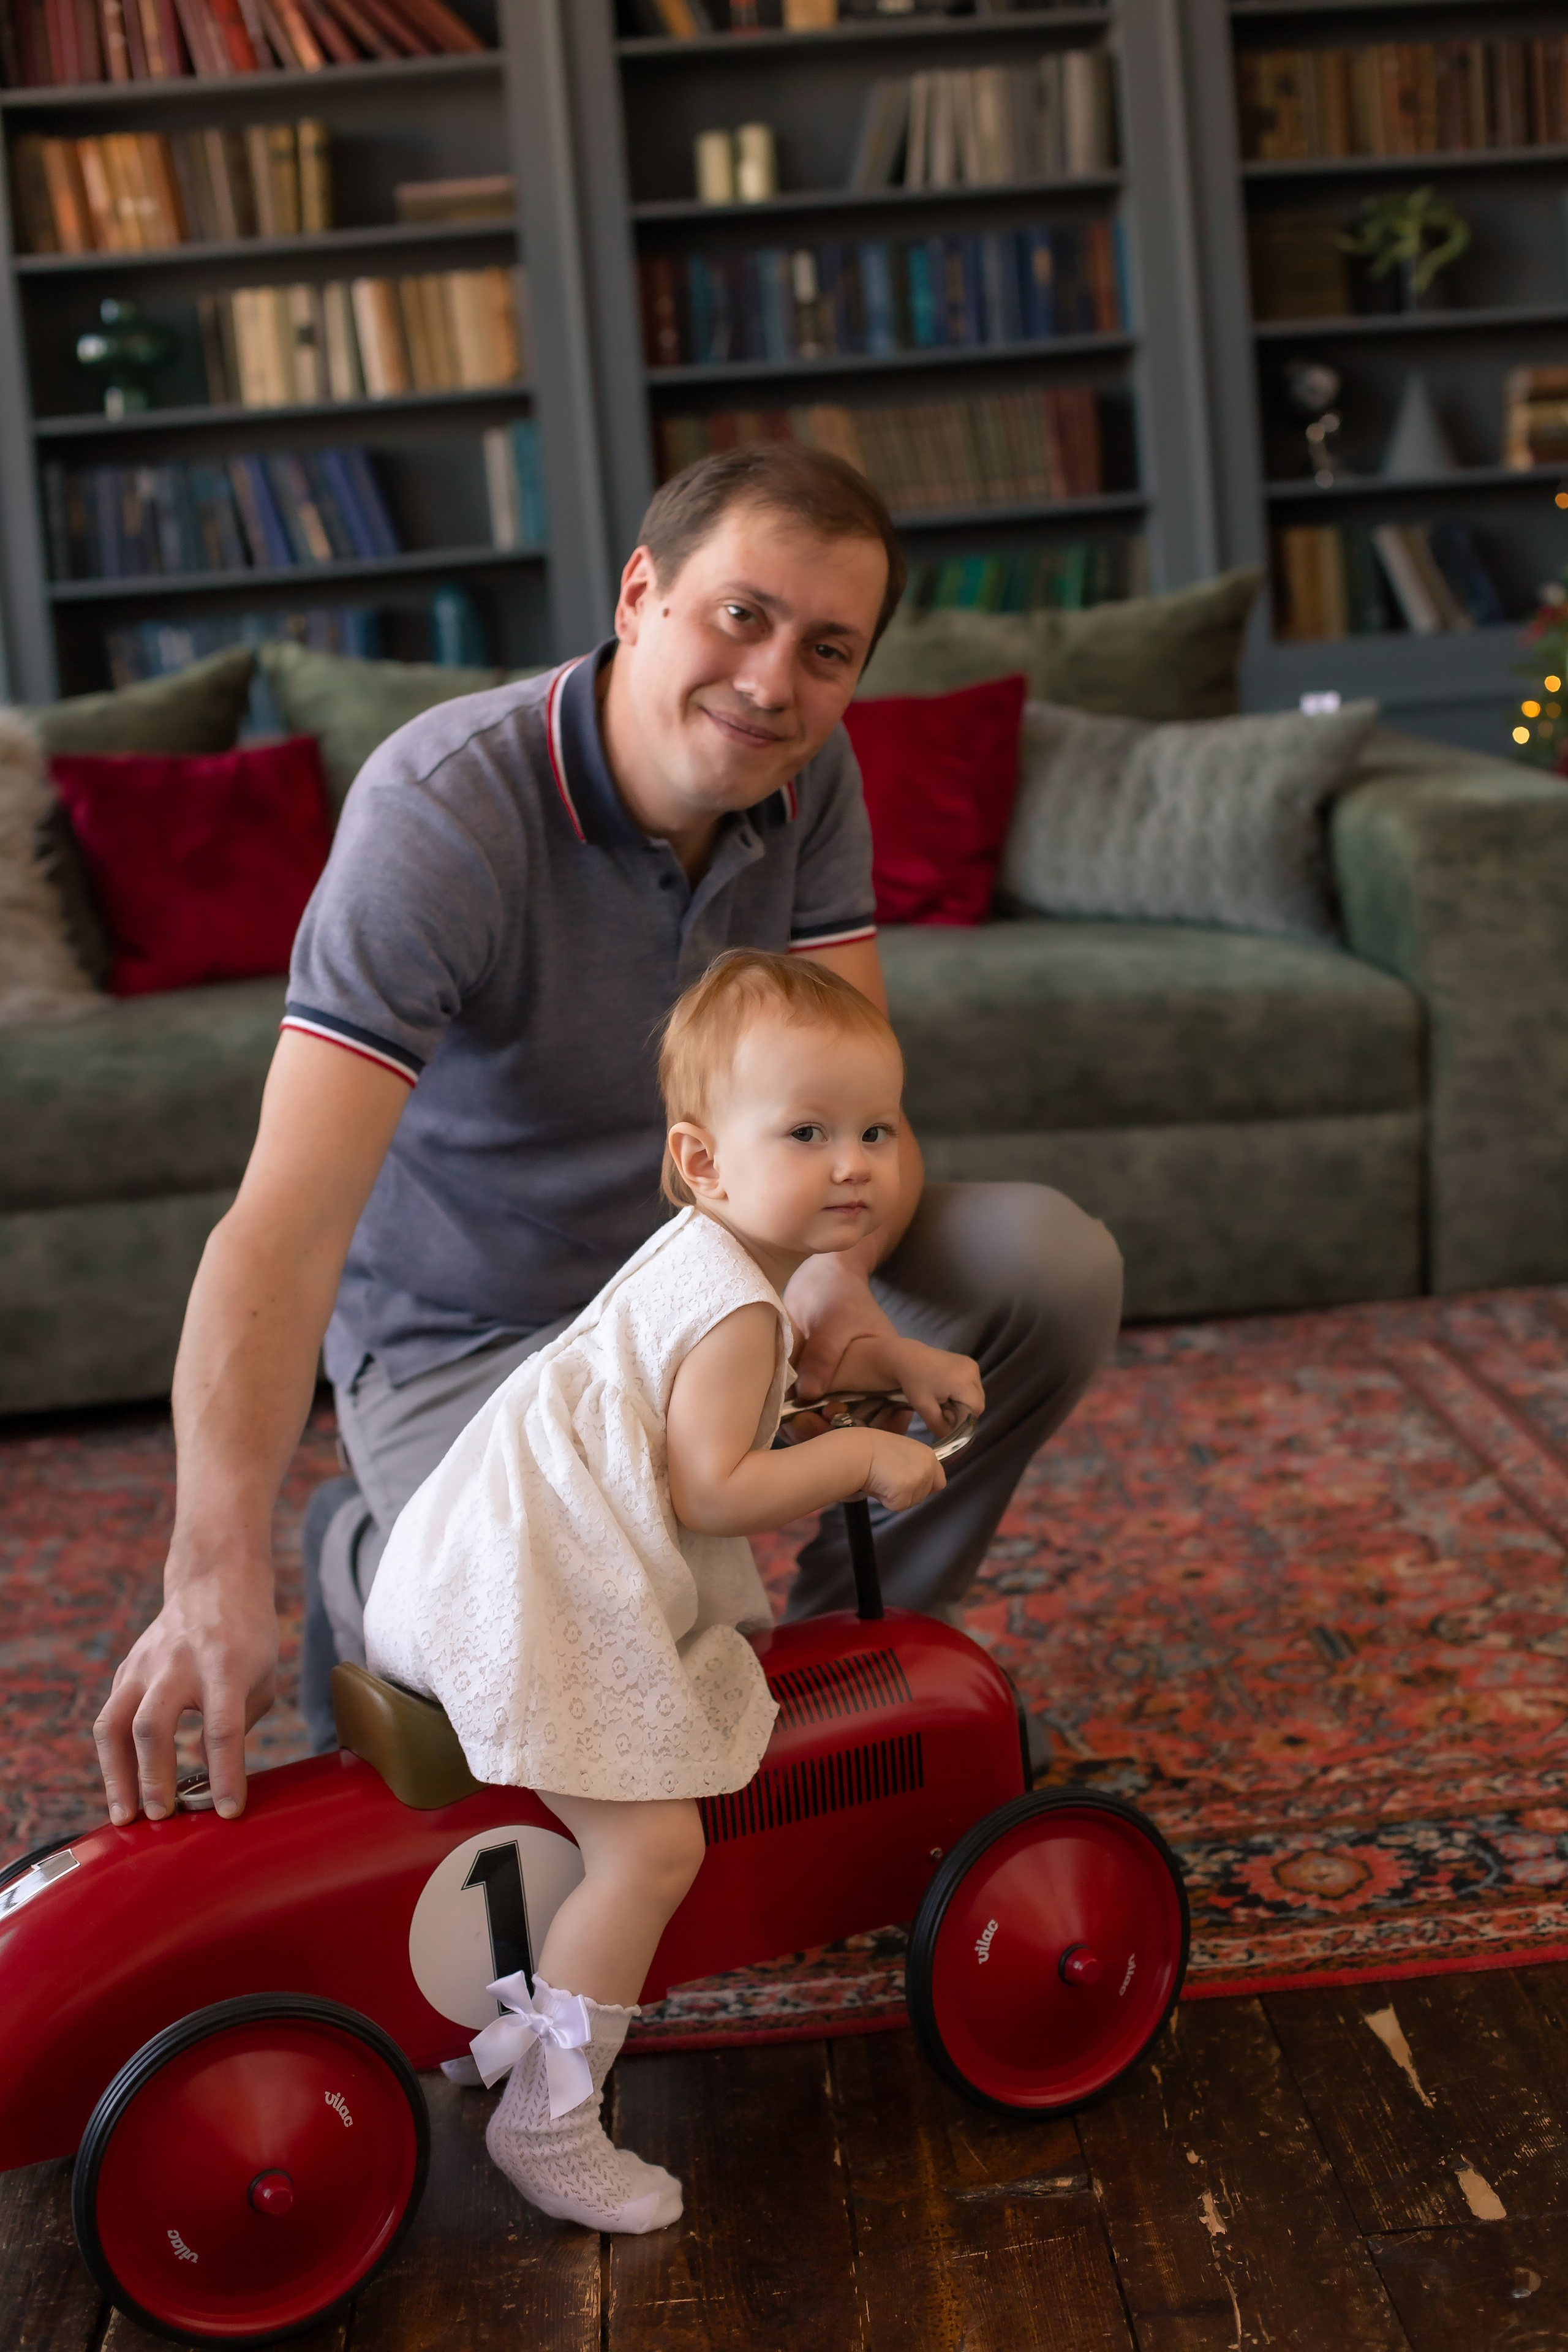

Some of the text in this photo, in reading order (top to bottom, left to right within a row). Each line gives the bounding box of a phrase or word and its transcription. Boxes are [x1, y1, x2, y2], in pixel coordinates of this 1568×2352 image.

[461, 1840, 535, 2016] 1
[974, 1919, 998, 1964] vilac
[325, 2091, 353, 2127] vilac
[167, 2230, 198, 2263] vilac
